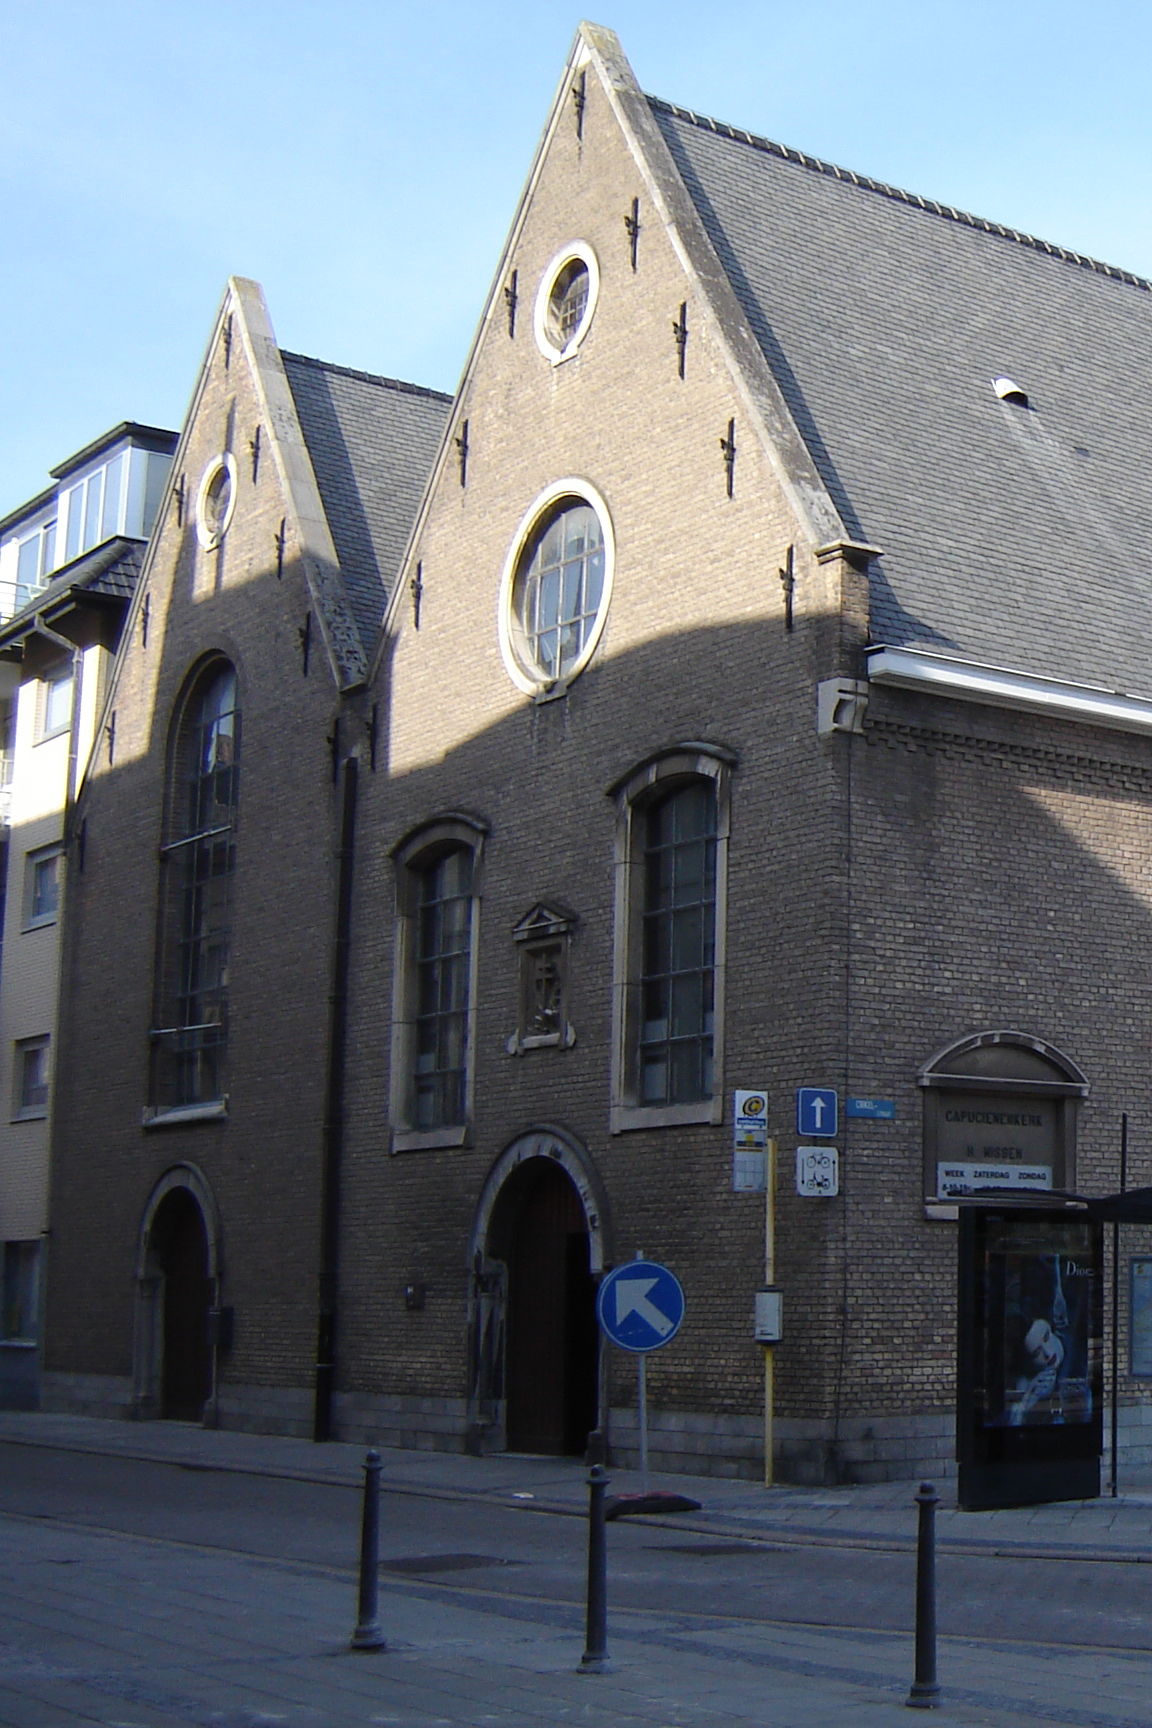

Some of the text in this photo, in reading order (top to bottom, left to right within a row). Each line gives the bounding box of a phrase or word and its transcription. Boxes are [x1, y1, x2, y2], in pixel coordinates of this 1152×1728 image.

[945, 1169, 1047, 1181] WEEK ZATERDAG ZONDAG
